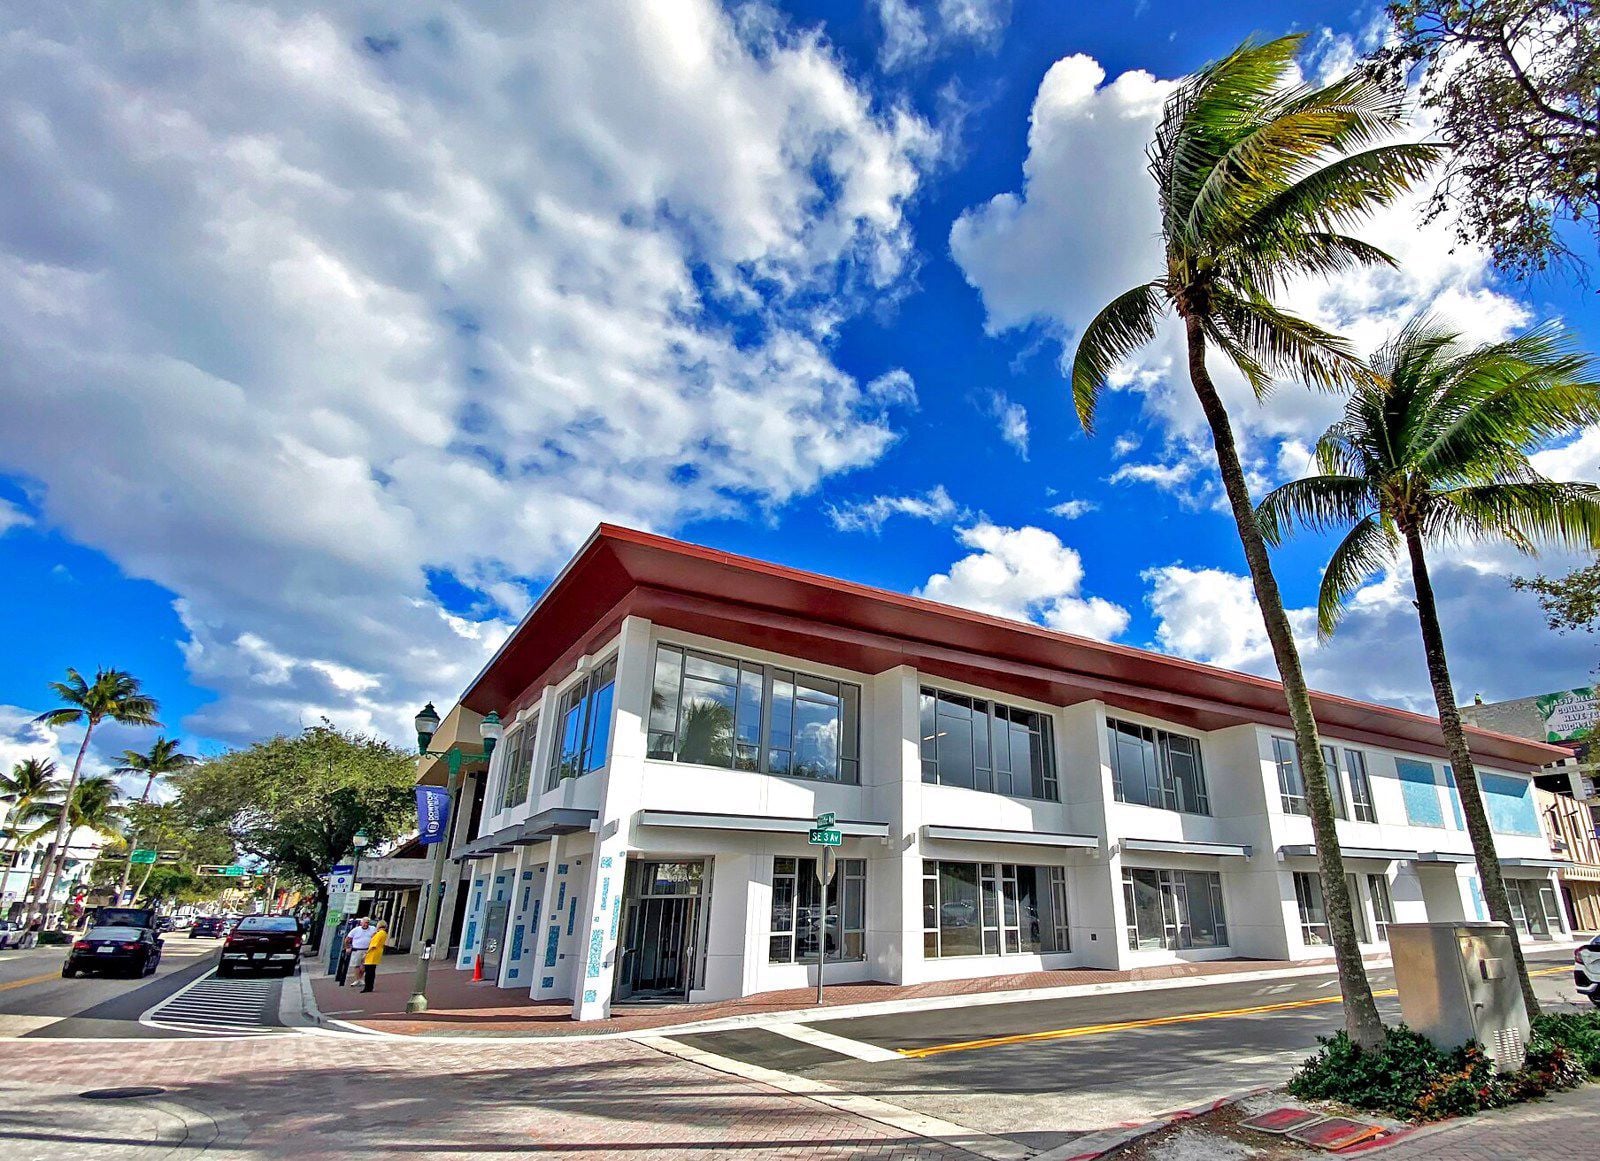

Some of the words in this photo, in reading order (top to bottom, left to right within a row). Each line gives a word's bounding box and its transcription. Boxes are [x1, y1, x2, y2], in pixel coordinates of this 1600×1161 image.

[1557, 703, 1584, 714] COULD
[1563, 712, 1588, 722] HAVE
[1557, 721, 1582, 732] MUCH
[812, 831, 822, 842] SE
[823, 832, 829, 842] 3
